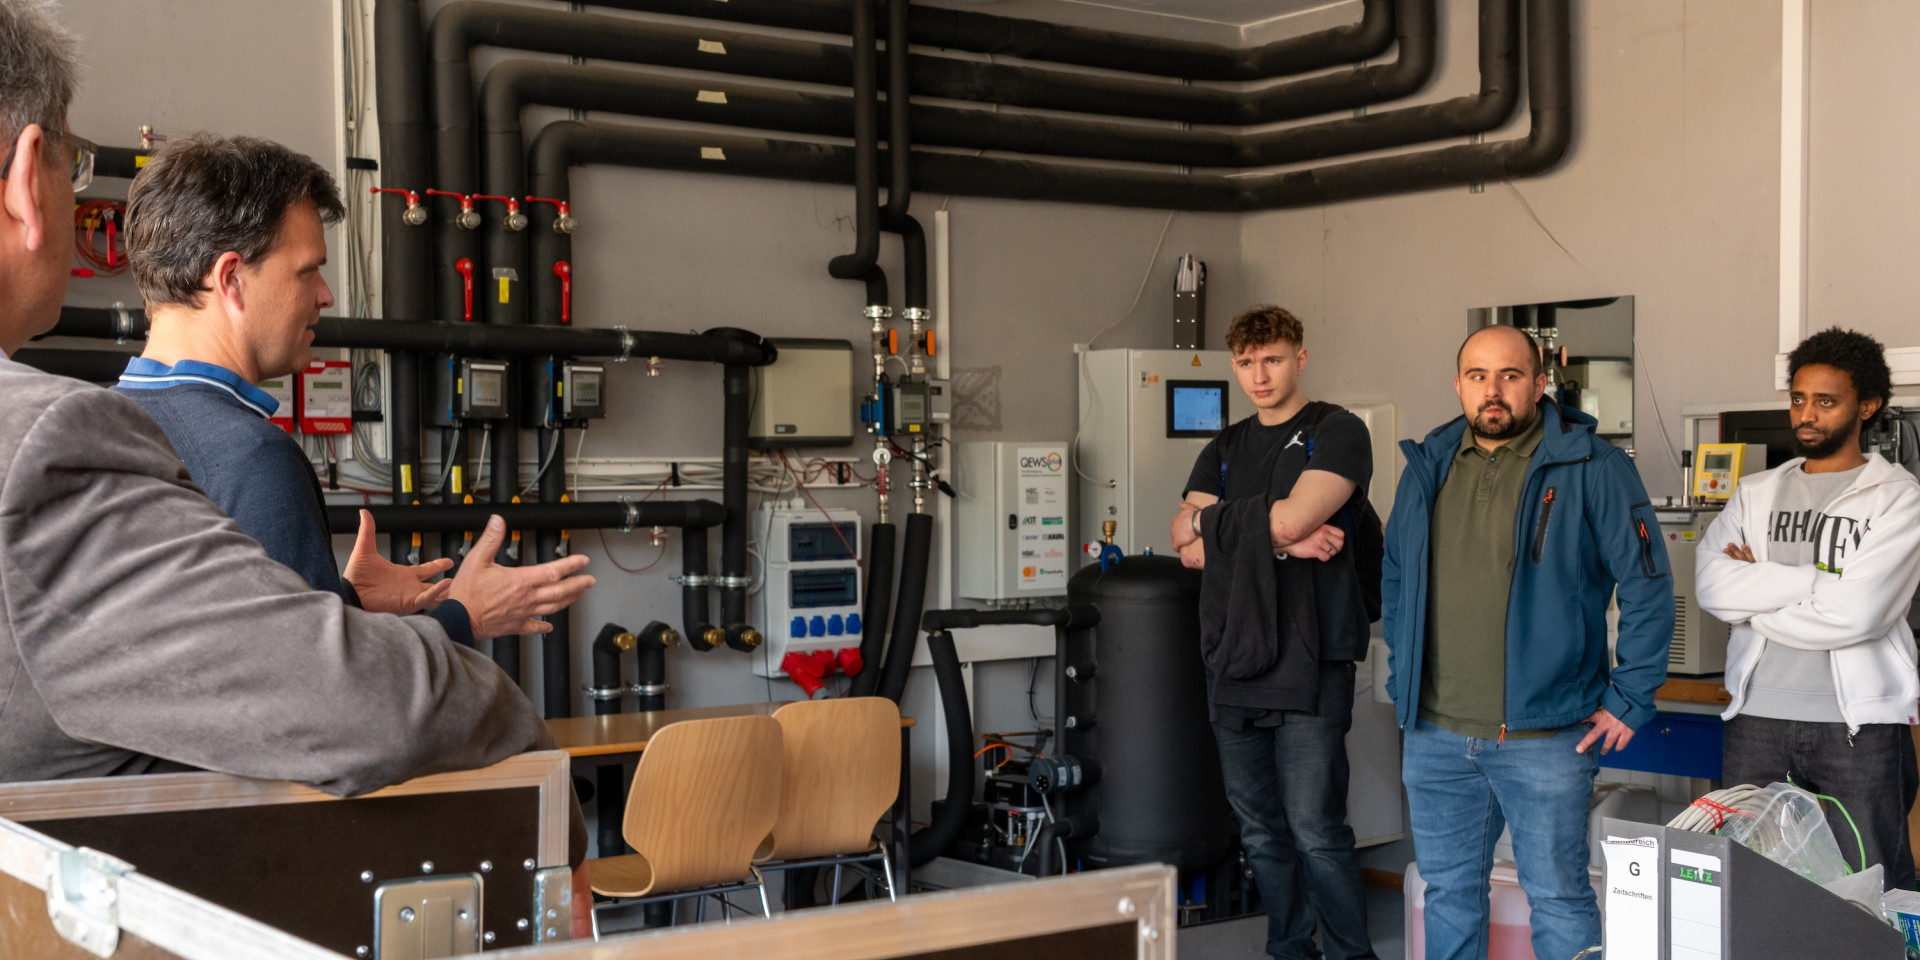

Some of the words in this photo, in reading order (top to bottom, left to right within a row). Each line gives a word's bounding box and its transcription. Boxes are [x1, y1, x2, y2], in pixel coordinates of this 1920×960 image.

[1020, 457, 1047, 468] QEWS
[1629, 861, 1641, 877] G
[1613, 887, 1653, 900] Zeitschriften
